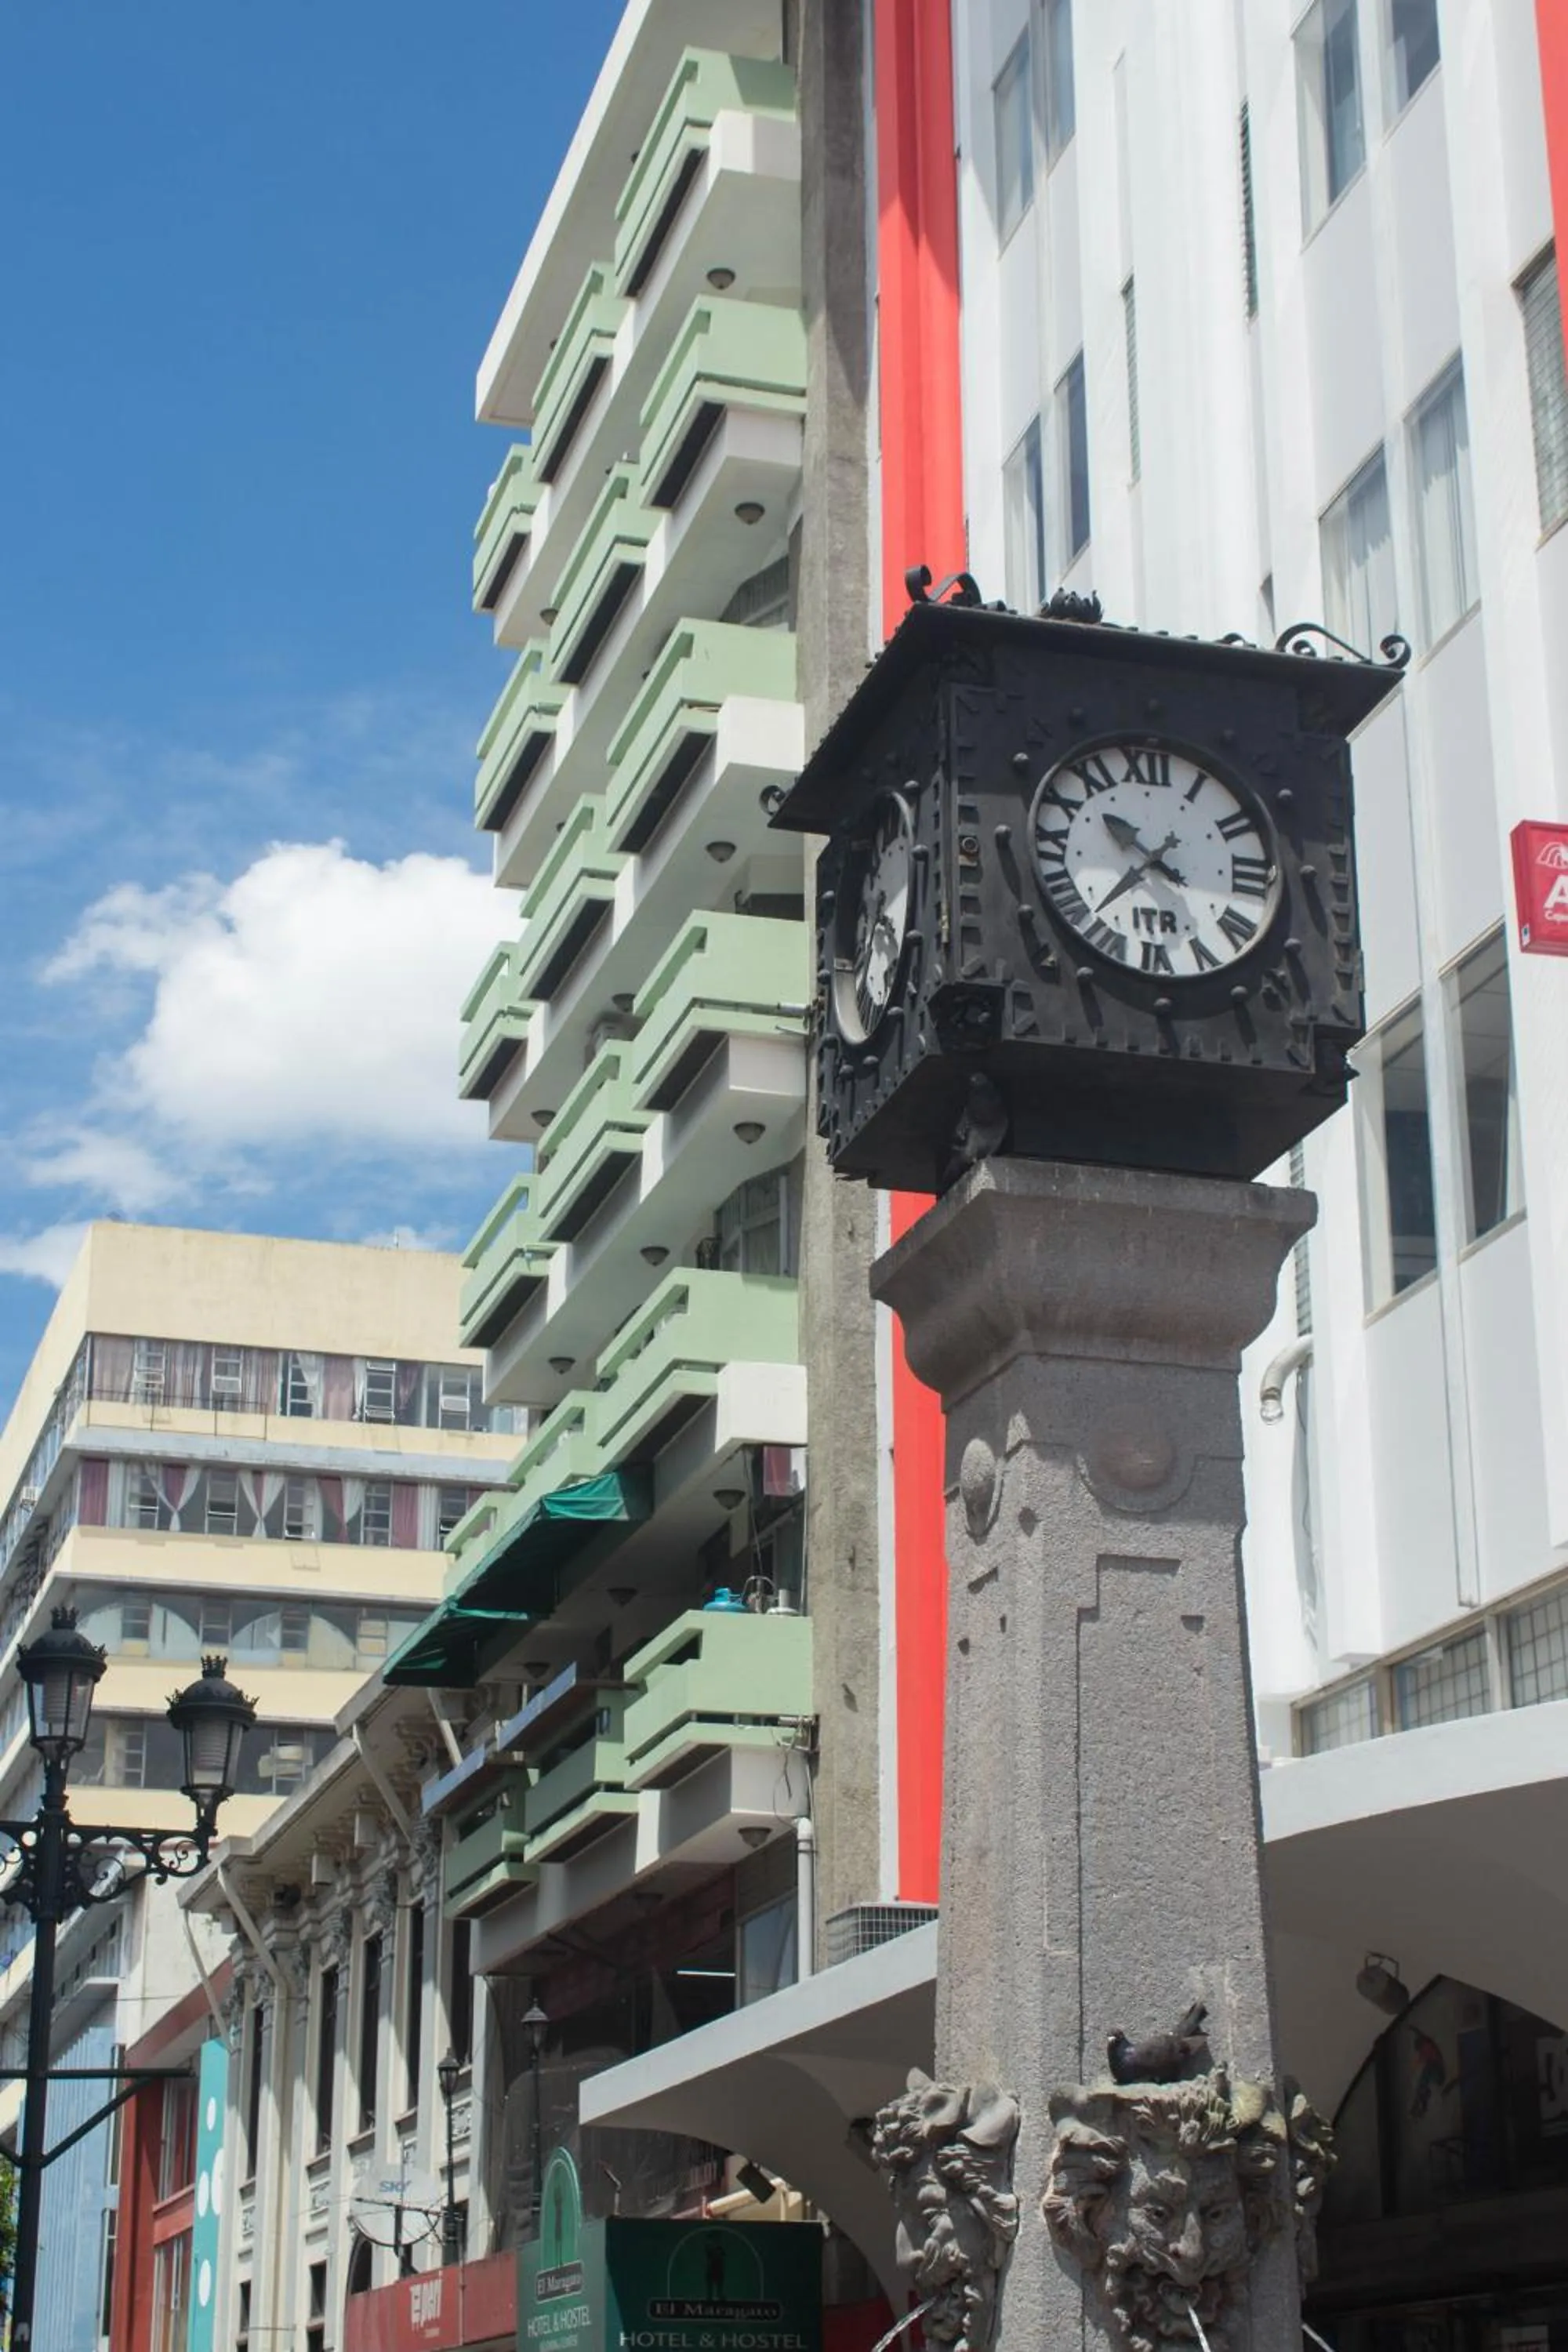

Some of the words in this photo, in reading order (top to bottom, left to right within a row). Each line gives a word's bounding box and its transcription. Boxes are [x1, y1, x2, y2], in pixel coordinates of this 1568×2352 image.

[1070, 757, 1119, 800] XI
[1120, 747, 1173, 787] XII
[1184, 771, 1209, 804] I
[1215, 809, 1252, 843] II
[1231, 853, 1268, 899] III
[1132, 906, 1177, 934] ITR
[1141, 941, 1176, 976] VI
[1189, 936, 1224, 971] V
[537, 2279, 546, 2296] El
[528, 2314, 553, 2339] HOTEL
[560, 2305, 592, 2331] HOSTEL
[655, 2302, 676, 2315] El
[619, 2332, 694, 2348] HOTEL
[699, 2332, 716, 2348] &
[722, 2332, 808, 2350] HOSTEL
